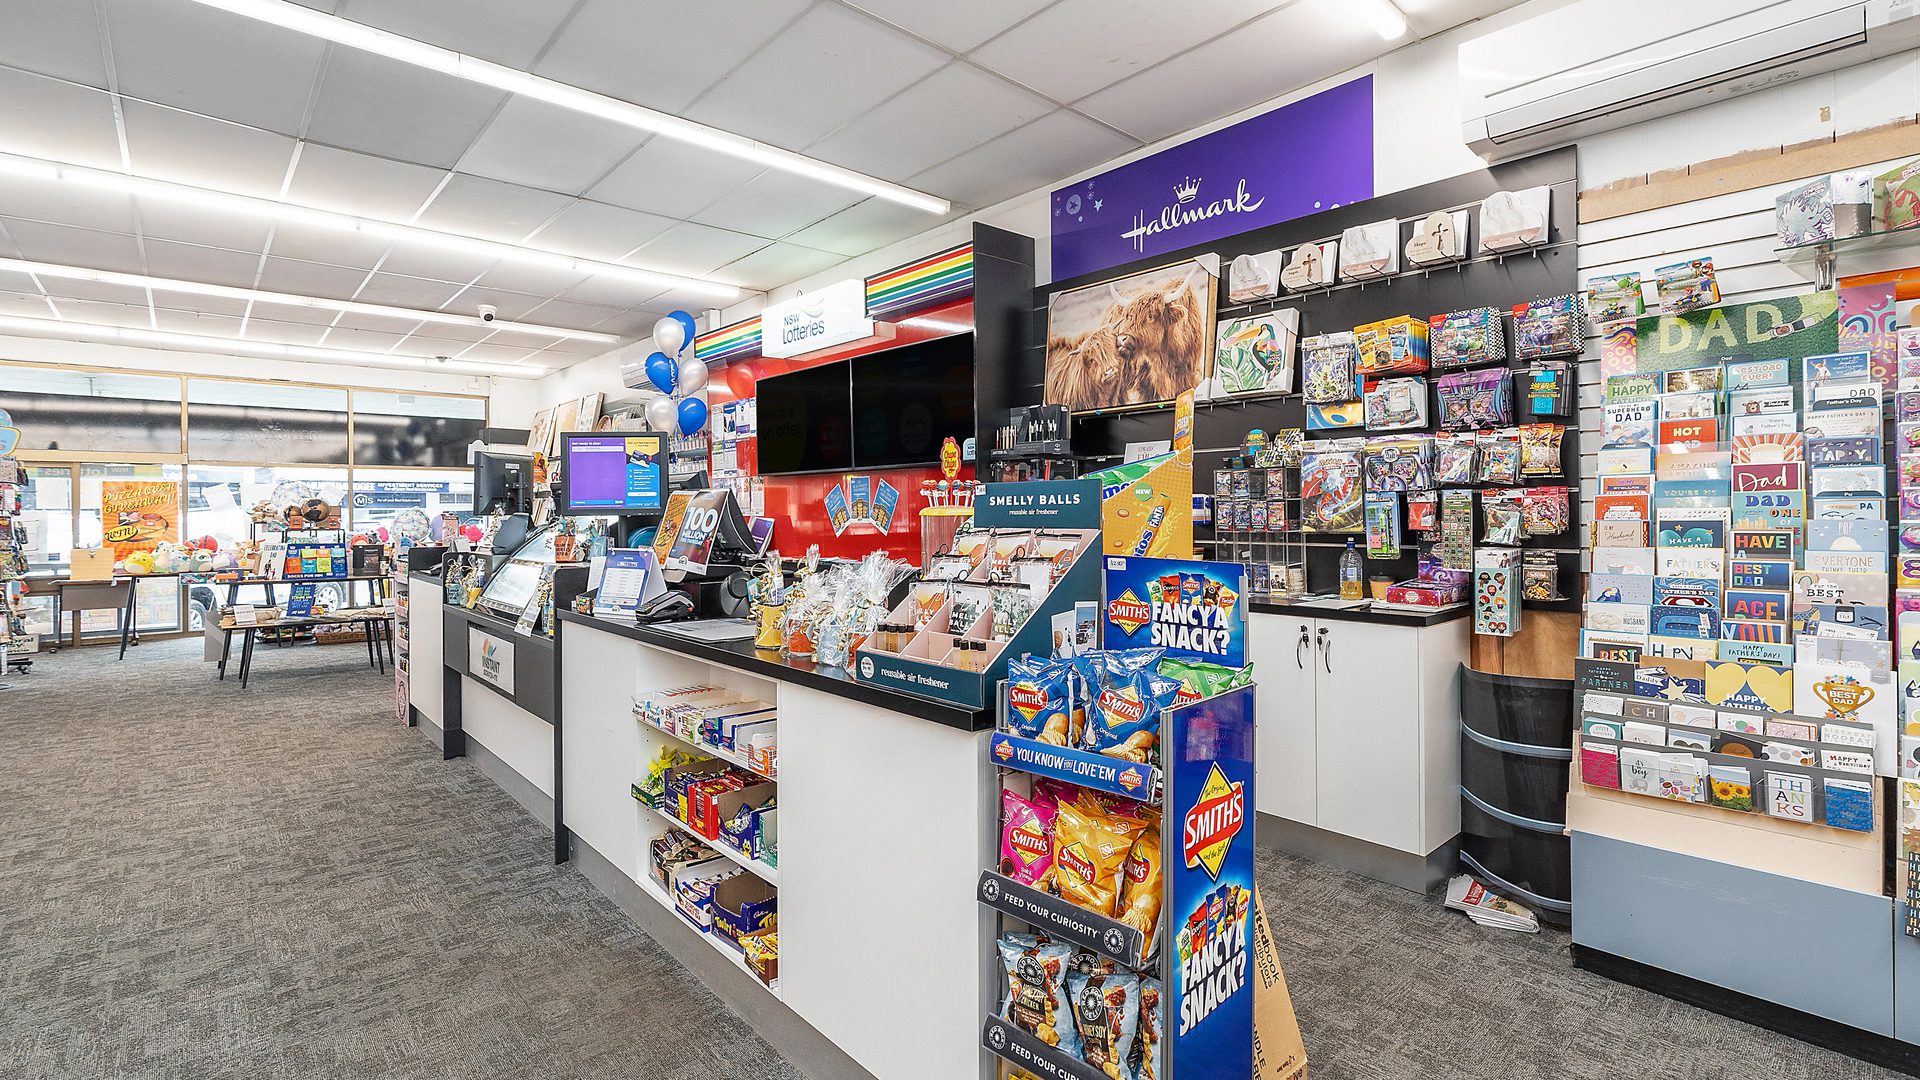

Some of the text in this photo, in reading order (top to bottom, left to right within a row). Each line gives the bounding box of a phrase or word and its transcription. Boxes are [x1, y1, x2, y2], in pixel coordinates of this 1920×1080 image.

[1120, 178, 1265, 253] Hallmark
[783, 313, 800, 327] NSW
[782, 319, 825, 345] Lotteries
[1659, 303, 1783, 354] DAD
[1612, 384, 1652, 397] HAPPY
[1850, 388, 1876, 398] DAD
[1607, 405, 1651, 415] SUPERHERO
[1615, 412, 1642, 423] DAD
[775, 424, 802, 439] offer
[1673, 426, 1702, 437] HOT
[1738, 465, 1788, 492] Dad
[103, 482, 176, 503] PIZZA OVEN
[104, 493, 176, 514] GIVEAWAY!
[989, 493, 1081, 507] SMELLY BALLS
[1859, 502, 1874, 510] PA
[1769, 508, 1801, 518] ONE
[105, 527, 135, 540] WIN!
[1605, 530, 1635, 540] Husband
[1669, 537, 1693, 545] HAVE
[1735, 535, 1787, 549] HAVE
[1736, 549, 1747, 559] A
[1666, 559, 1720, 569] FATHER'S
[1814, 556, 1874, 567] EVERYONE
[1682, 570, 1701, 578] DAY
[1733, 563, 1773, 575] BEST
[1182, 581, 1200, 589] SMITH'S
[1734, 576, 1764, 586] DAD
[1807, 588, 1845, 598] BEST
[1109, 602, 1150, 620] SMITH'S
[1152, 601, 1229, 630] FANCY A
[1622, 617, 1646, 626] HUSBAND
[1150, 622, 1231, 656] SNACK?
[1600, 649, 1638, 662] BEST
[880, 668, 950, 690] reusable air freshener
[1581, 678, 1629, 689] PARTNER
[1636, 674, 1659, 685] Daddy
[1010, 688, 1048, 707] SMITH'S
[1726, 692, 1766, 705] HAPPY
[1829, 690, 1858, 699] BEST
[1832, 697, 1854, 705] DAD
[1101, 691, 1141, 722] SMITH'S
[1824, 726, 1873, 738] BIRTHDAY
[1824, 733, 1872, 745] HOORAY
[995, 745, 1014, 756] SMITH'S
[1016, 747, 1034, 762] YOU
[1034, 750, 1064, 771] KNOW
[1063, 759, 1073, 770] YOU
[1829, 755, 1859, 763] HAPPY
[1838, 761, 1872, 769] BIRTHDAY
[1119, 773, 1142, 784] SMITH'S
[1632, 765, 1649, 779] boy
[1774, 778, 1804, 792] TH
[1775, 790, 1805, 805] AN
[1776, 802, 1805, 817] KS
[1185, 791, 1243, 850] SMITH'S
[1011, 830, 1049, 853] SMITH'S
[1058, 846, 1095, 883] SMITH'S
[1004, 892, 1099, 939] FEED YOUR CURIOSITY
[1208, 900, 1224, 918] SMITH'S
[714, 916, 733, 934] Twirl
[1181, 919, 1246, 996] FANCY A
[1179, 951, 1247, 1037] SNACK?
[1096, 1024, 1107, 1039] SOY
[1011, 1042, 1057, 1071] FEED YOUR
